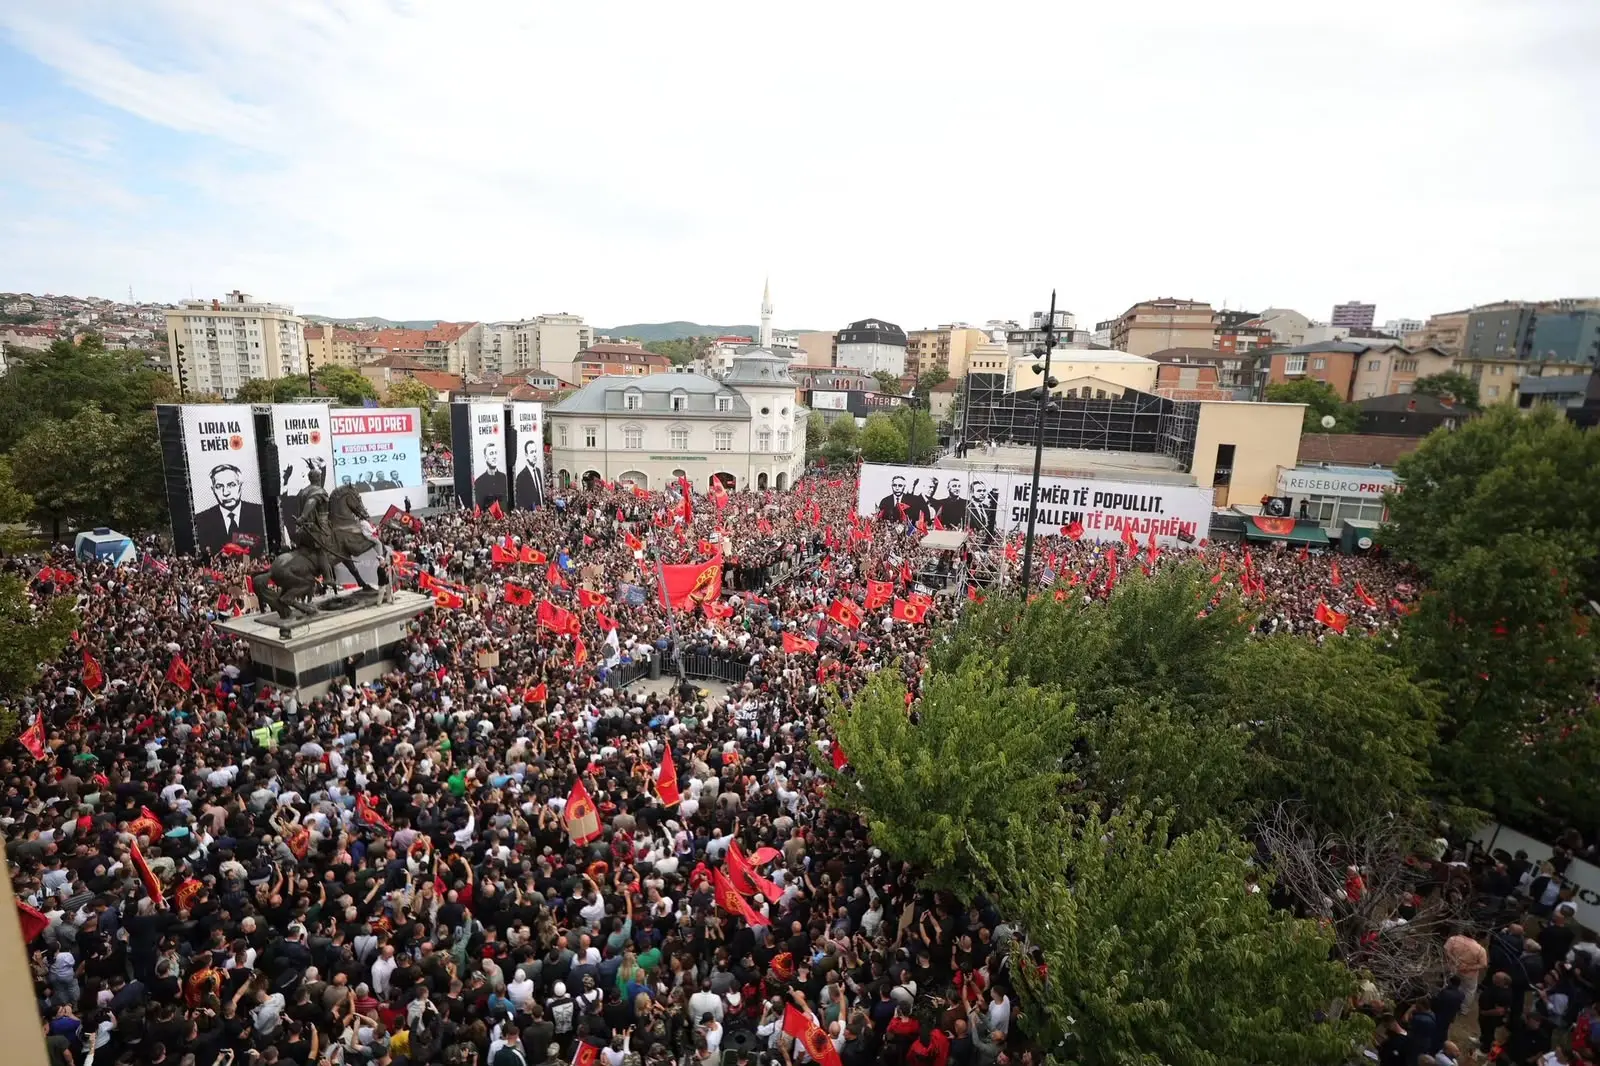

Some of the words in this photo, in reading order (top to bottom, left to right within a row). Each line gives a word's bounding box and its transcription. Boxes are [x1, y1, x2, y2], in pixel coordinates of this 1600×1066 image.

[864, 397, 902, 406] INTEREX
[284, 418, 306, 430] LIRIA
[308, 418, 320, 429] KA
[368, 416, 382, 432] PO
[383, 416, 407, 432] PRET
[478, 414, 492, 423] LIRIA
[519, 413, 531, 422] LIRIA
[198, 421, 226, 434] LIRIA
[228, 420, 241, 433] KA
[200, 436, 229, 452] EMËR
[286, 432, 309, 446] EMËR
[352, 455, 367, 465] 19
[372, 454, 387, 463] 32
[392, 452, 406, 461] 49
[1013, 482, 1032, 502] NË
[1073, 486, 1089, 507] TË
[1093, 491, 1165, 515] POPULLIT,
[1012, 506, 1084, 526] SHALLENI
[1087, 510, 1103, 530] TË
